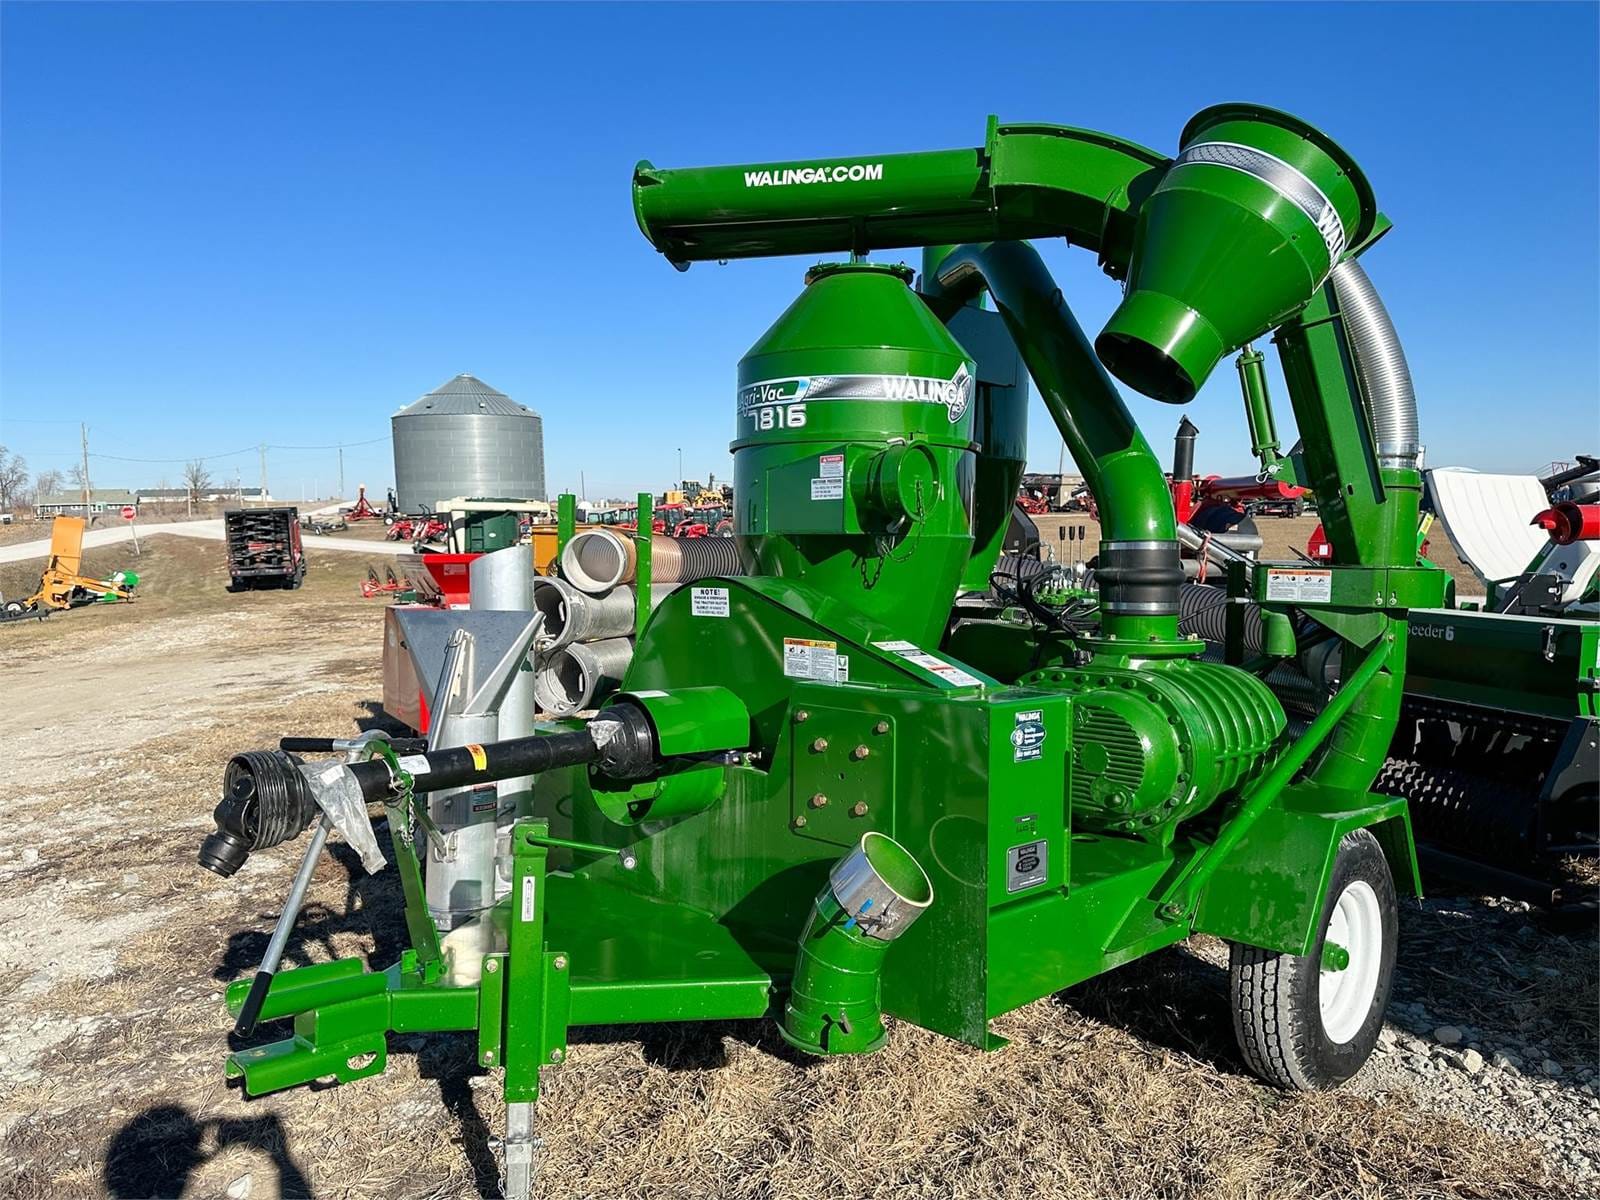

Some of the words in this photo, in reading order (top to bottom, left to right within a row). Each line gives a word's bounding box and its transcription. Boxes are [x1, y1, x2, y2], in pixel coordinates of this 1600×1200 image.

[882, 375, 966, 404] WALINGA
[747, 404, 807, 431] 7816
[1445, 626, 1455, 641] 6
